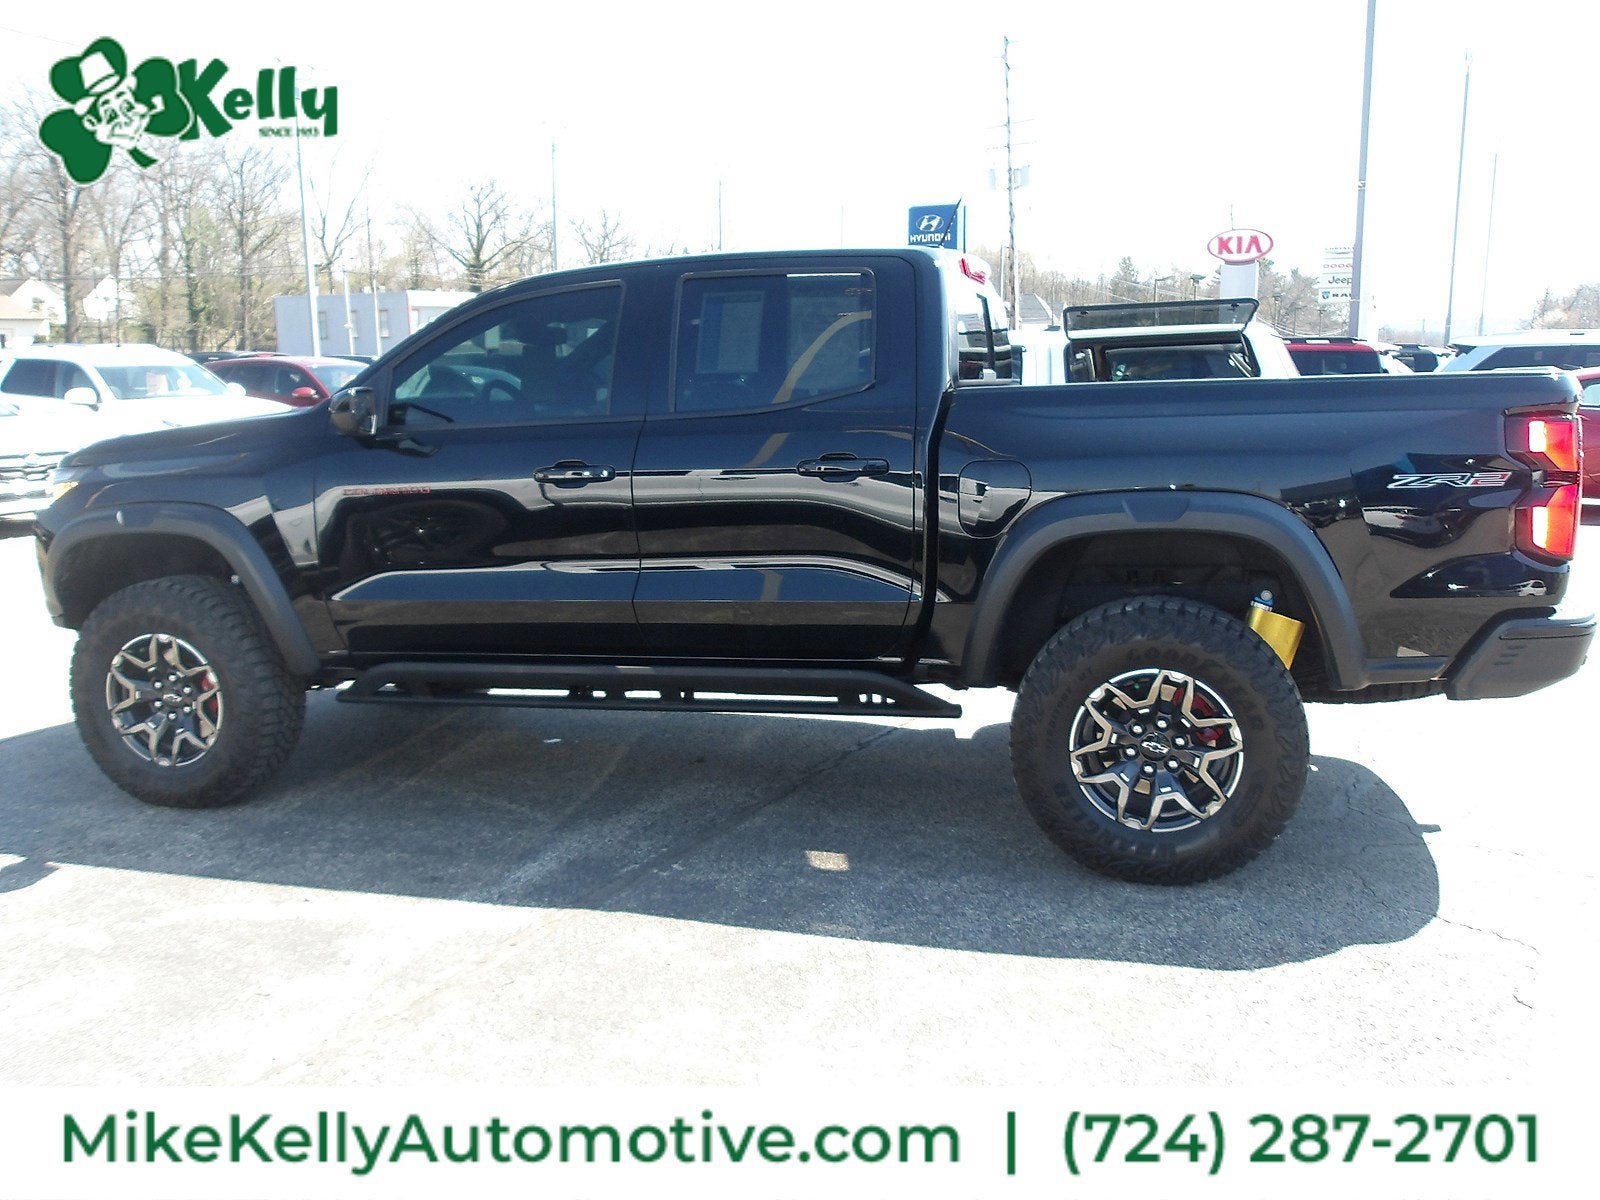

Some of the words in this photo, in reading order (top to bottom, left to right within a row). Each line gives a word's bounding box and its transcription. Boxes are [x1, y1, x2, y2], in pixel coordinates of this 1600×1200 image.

[909, 232, 951, 243] HYUNDAI
[1217, 234, 1263, 255] KIA
[1386, 471, 1513, 489] ZR2
